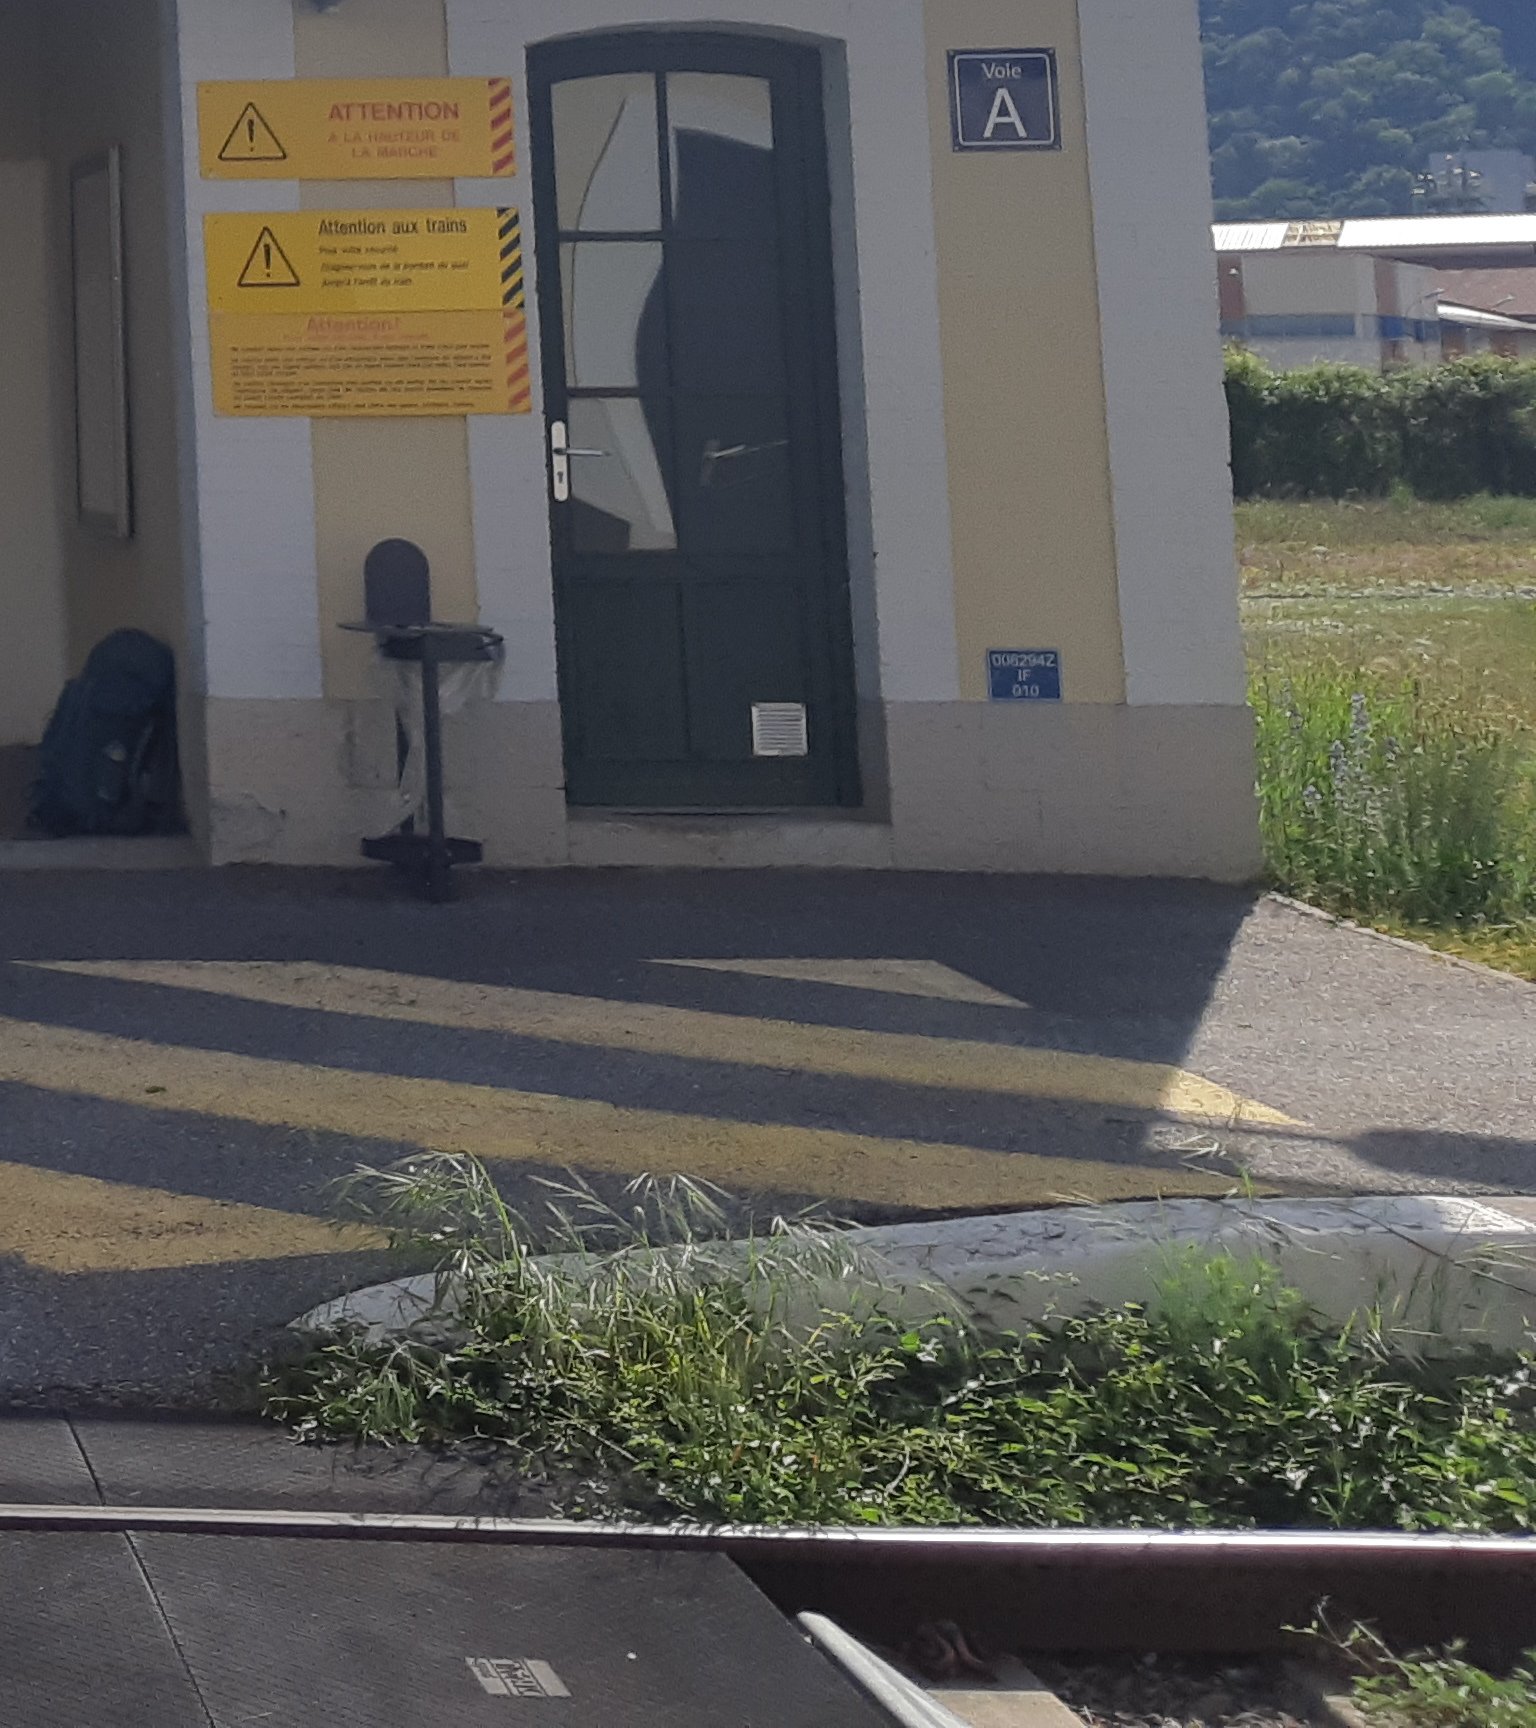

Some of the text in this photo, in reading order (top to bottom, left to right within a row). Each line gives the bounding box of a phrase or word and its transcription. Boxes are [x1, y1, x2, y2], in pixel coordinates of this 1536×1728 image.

[981, 62, 1022, 79] Voie
[330, 102, 459, 120] ATTENTION
[983, 88, 1027, 138] A
[319, 218, 467, 235] Attention aux trains
[1012, 684, 1040, 697] 010
